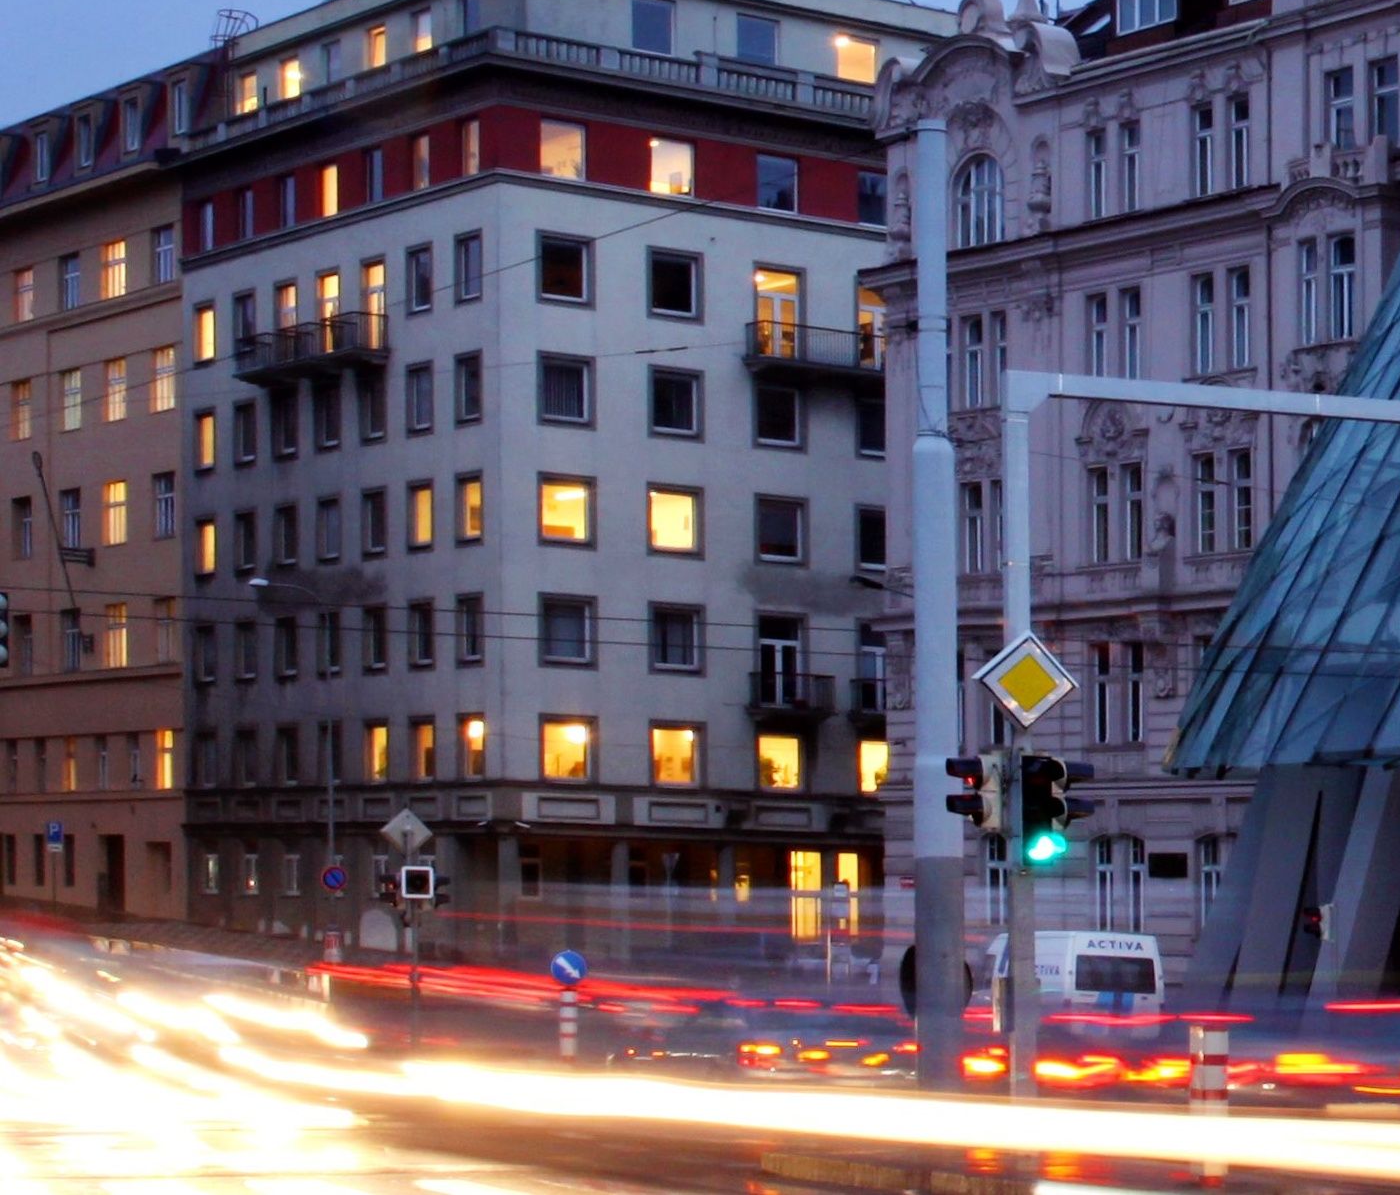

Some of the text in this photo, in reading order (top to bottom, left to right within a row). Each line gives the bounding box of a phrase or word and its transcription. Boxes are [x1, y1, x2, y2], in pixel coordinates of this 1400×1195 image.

[50, 823, 60, 836] P
[1087, 940, 1144, 951] ACTIVA
[1034, 964, 1060, 975] CTIVA
